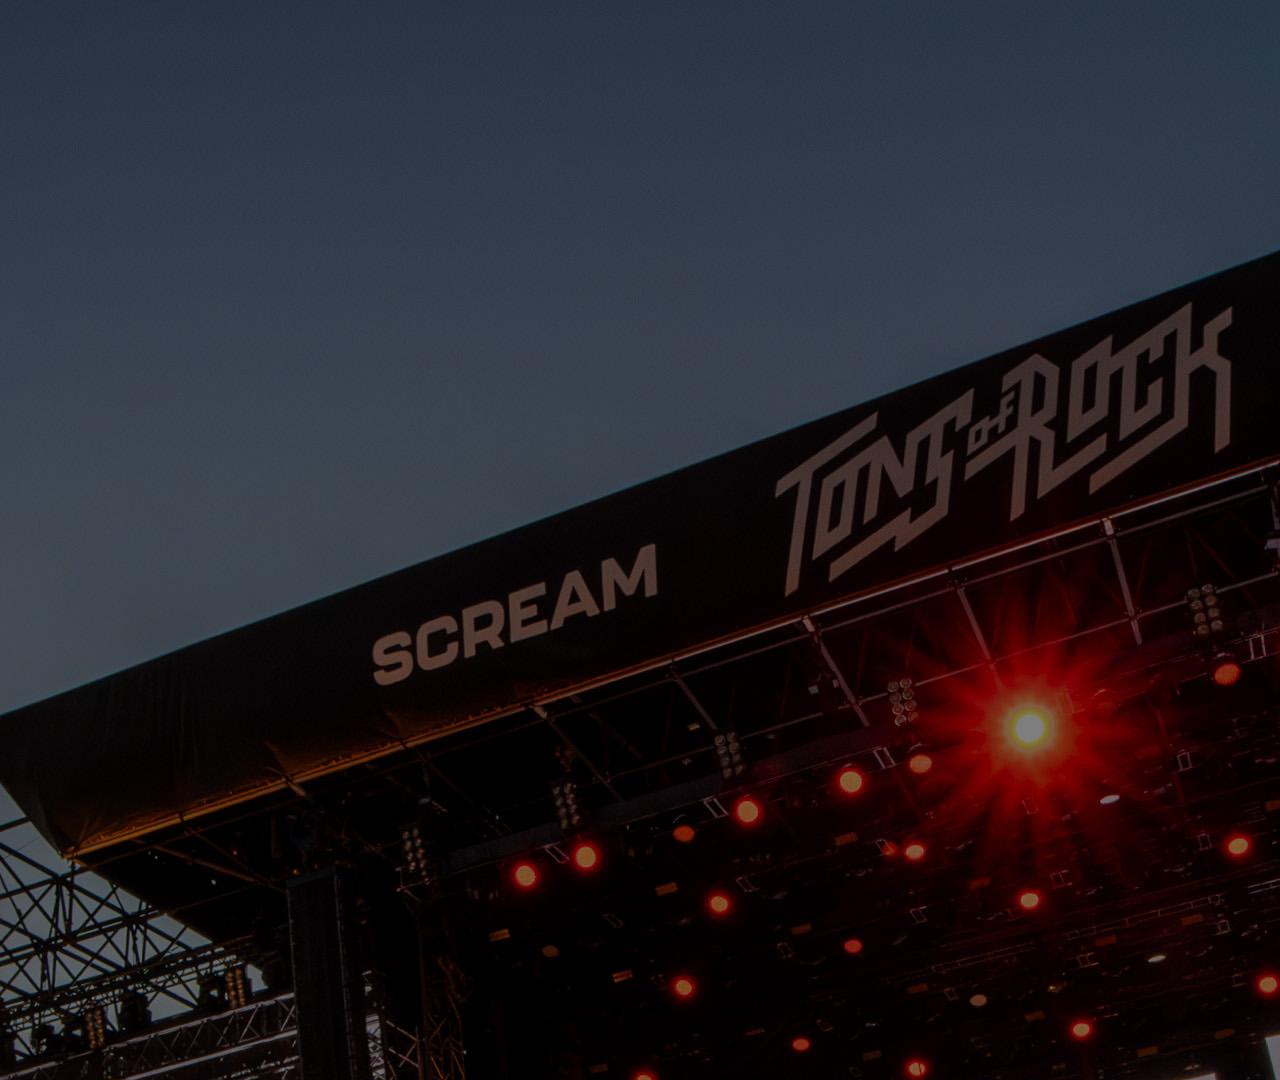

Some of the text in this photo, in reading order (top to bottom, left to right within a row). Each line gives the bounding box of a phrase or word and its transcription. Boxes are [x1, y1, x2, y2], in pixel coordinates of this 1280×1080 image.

[774, 386, 976, 599] TONS
[963, 301, 1234, 523] ROCK
[371, 543, 659, 687] SCREAM
